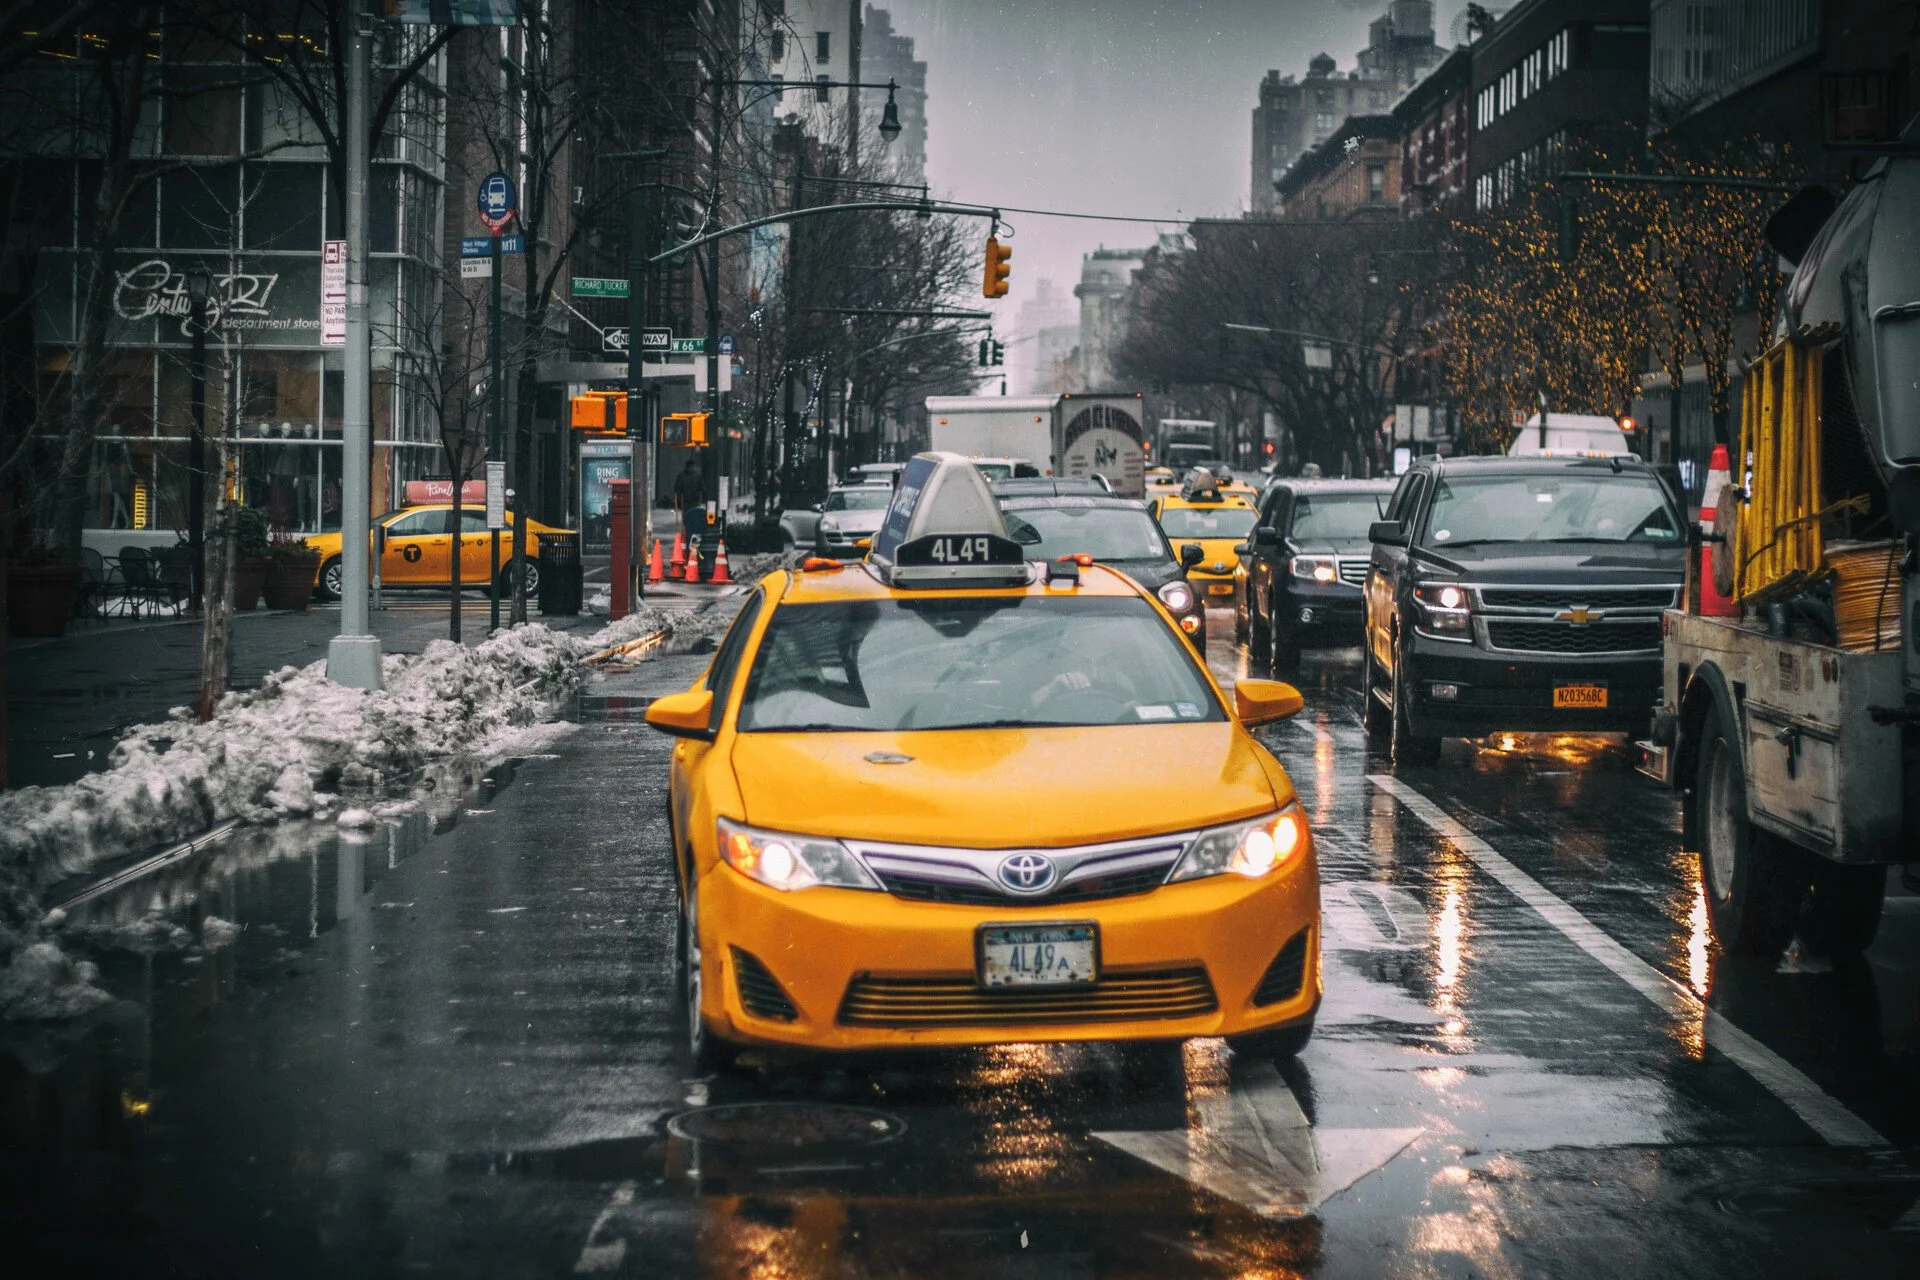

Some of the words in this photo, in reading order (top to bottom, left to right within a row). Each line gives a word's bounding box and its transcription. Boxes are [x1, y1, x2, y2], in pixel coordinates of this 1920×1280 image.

[502, 237, 516, 251] M11
[574, 279, 602, 290] RICHARD
[604, 281, 628, 291] TUCKER
[113, 259, 220, 338] Centuy
[226, 318, 290, 330] department
[293, 318, 321, 329] store
[325, 317, 346, 326] Anytim
[612, 335, 630, 345] ONE
[643, 334, 665, 344] WAY
[673, 340, 679, 351] W
[682, 341, 694, 351] 66
[596, 467, 619, 477] RING
[931, 538, 990, 562] 4L49
